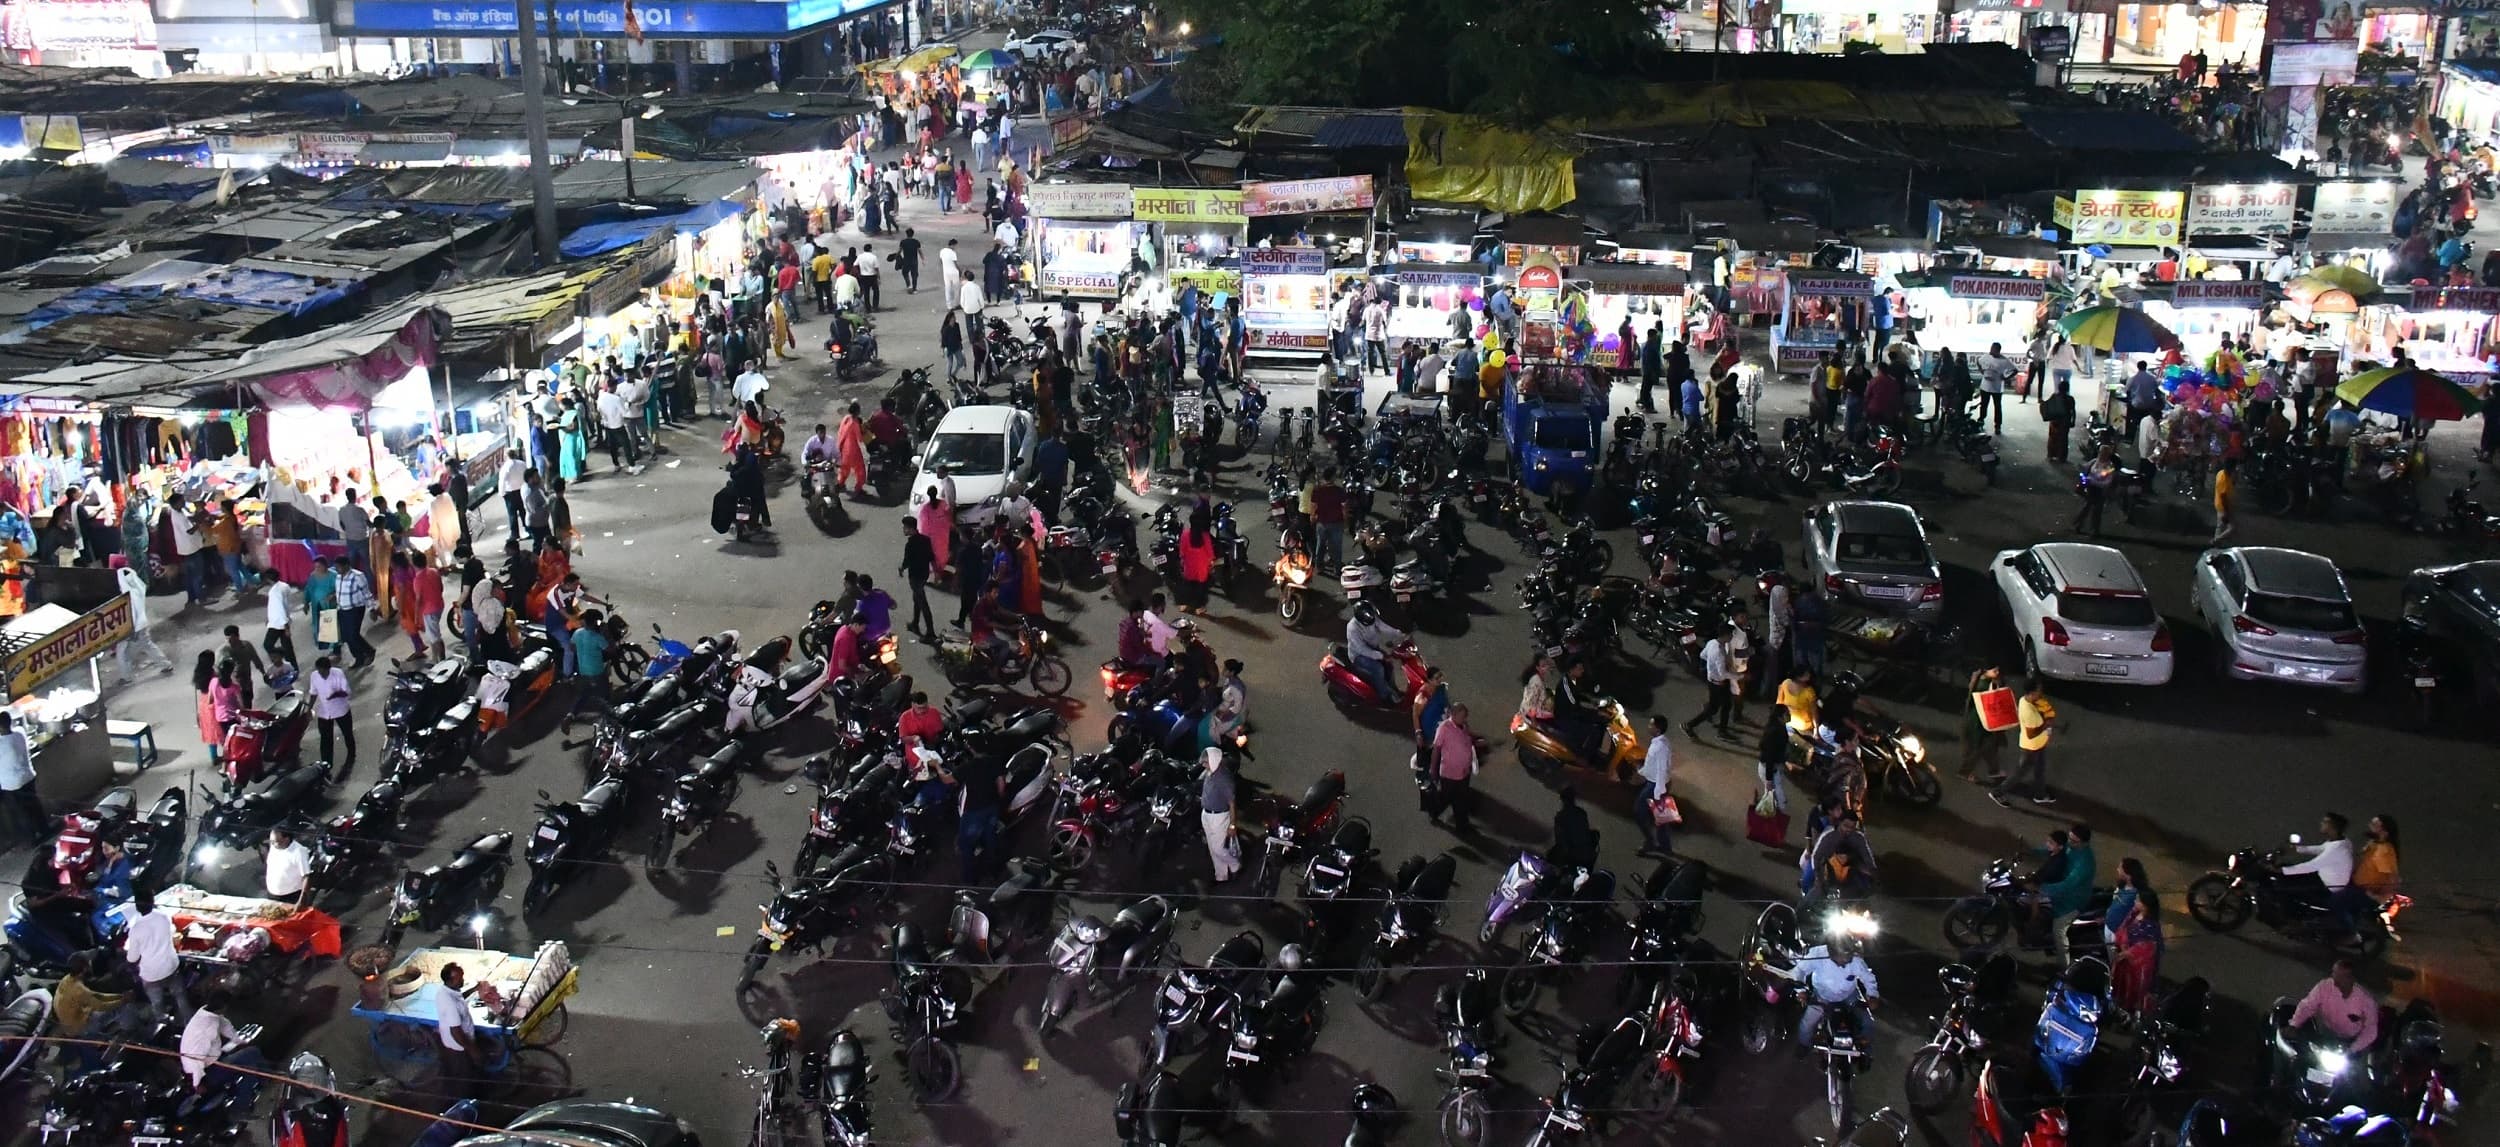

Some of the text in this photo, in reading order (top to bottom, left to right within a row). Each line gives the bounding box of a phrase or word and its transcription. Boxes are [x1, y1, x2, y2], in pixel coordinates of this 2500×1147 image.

[566, 9, 578, 22] of
[584, 9, 618, 23] India
[1138, 198, 1197, 215] मसाला
[2079, 199, 2124, 217] डोसा
[1251, 248, 1297, 264] संगीता
[1057, 276, 1116, 287] SPECIAL
[1402, 272, 1441, 284] SANJAY
[1800, 280, 1870, 290] KAJU SHAKE
[1952, 279, 2043, 297] BOKARO FAMOUS
[2176, 284, 2262, 298] MILKSHAKE
[1266, 331, 1303, 347] संगीता
[27, 623, 88, 674] मसाला
